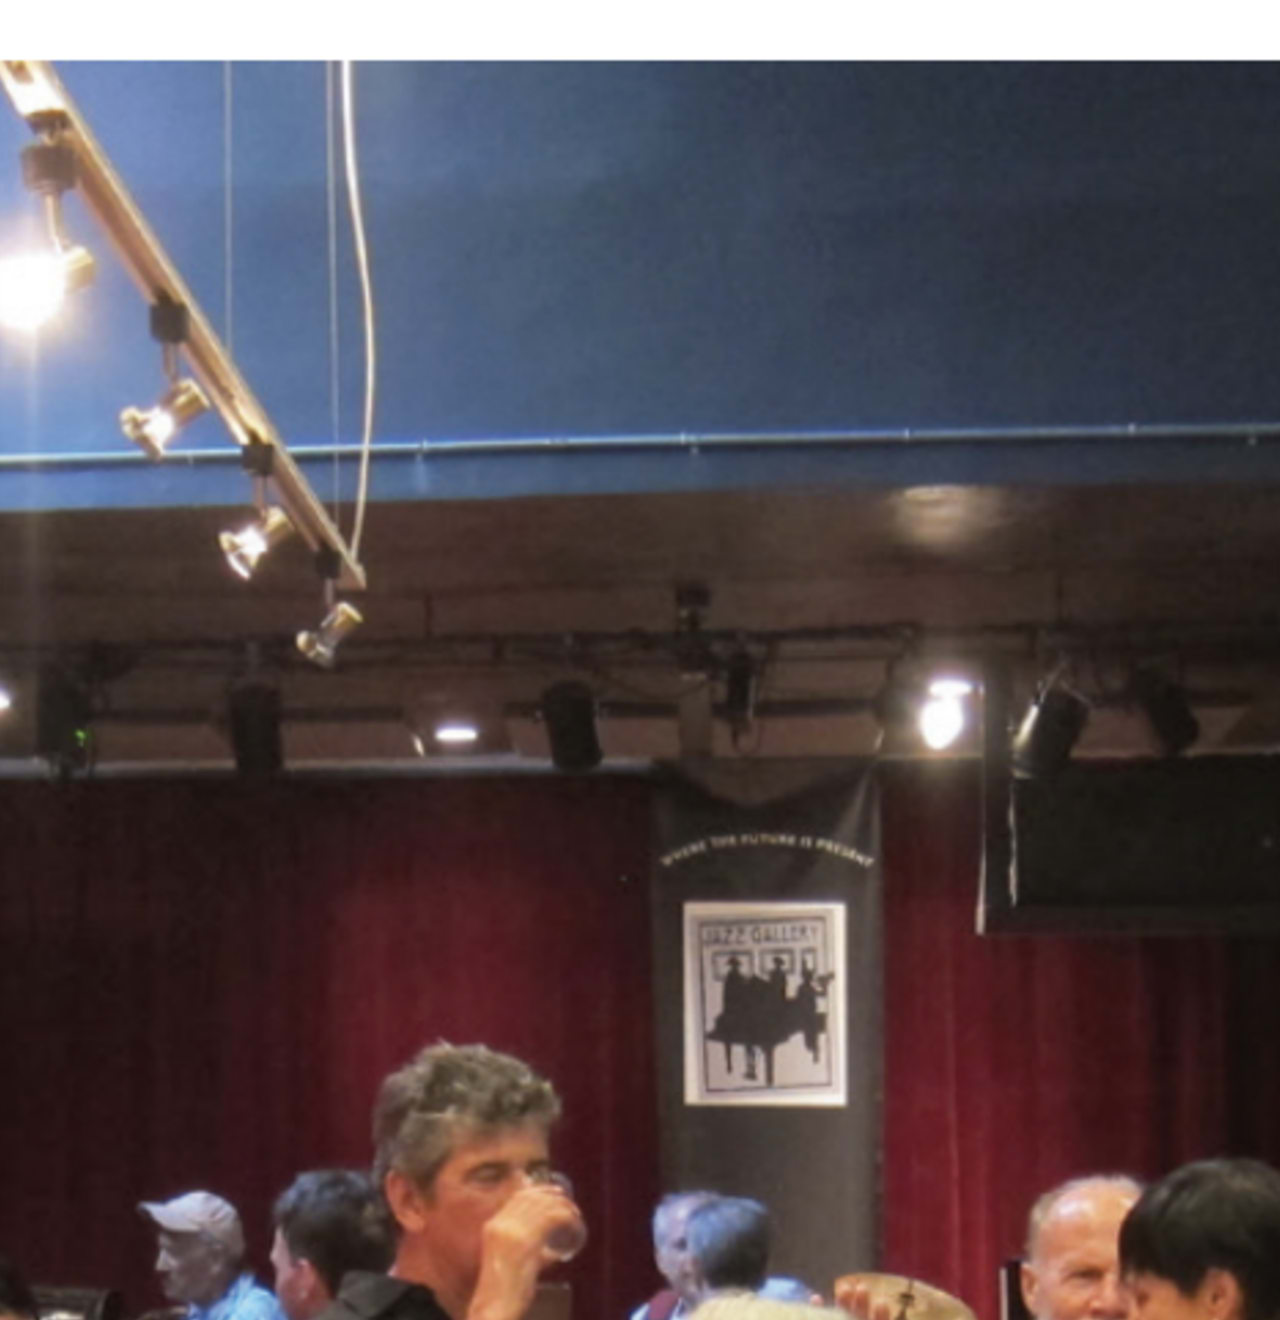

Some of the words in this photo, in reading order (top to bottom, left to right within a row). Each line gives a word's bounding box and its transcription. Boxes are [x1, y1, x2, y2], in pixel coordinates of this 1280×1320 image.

[660, 839, 707, 866] WHERE
[710, 834, 736, 848] THE
[740, 833, 796, 846] FUTURE
[800, 834, 812, 848] IS
[815, 838, 875, 867] PRESENT
[703, 925, 745, 945] JAZZ
[751, 924, 818, 944] GALLERY
